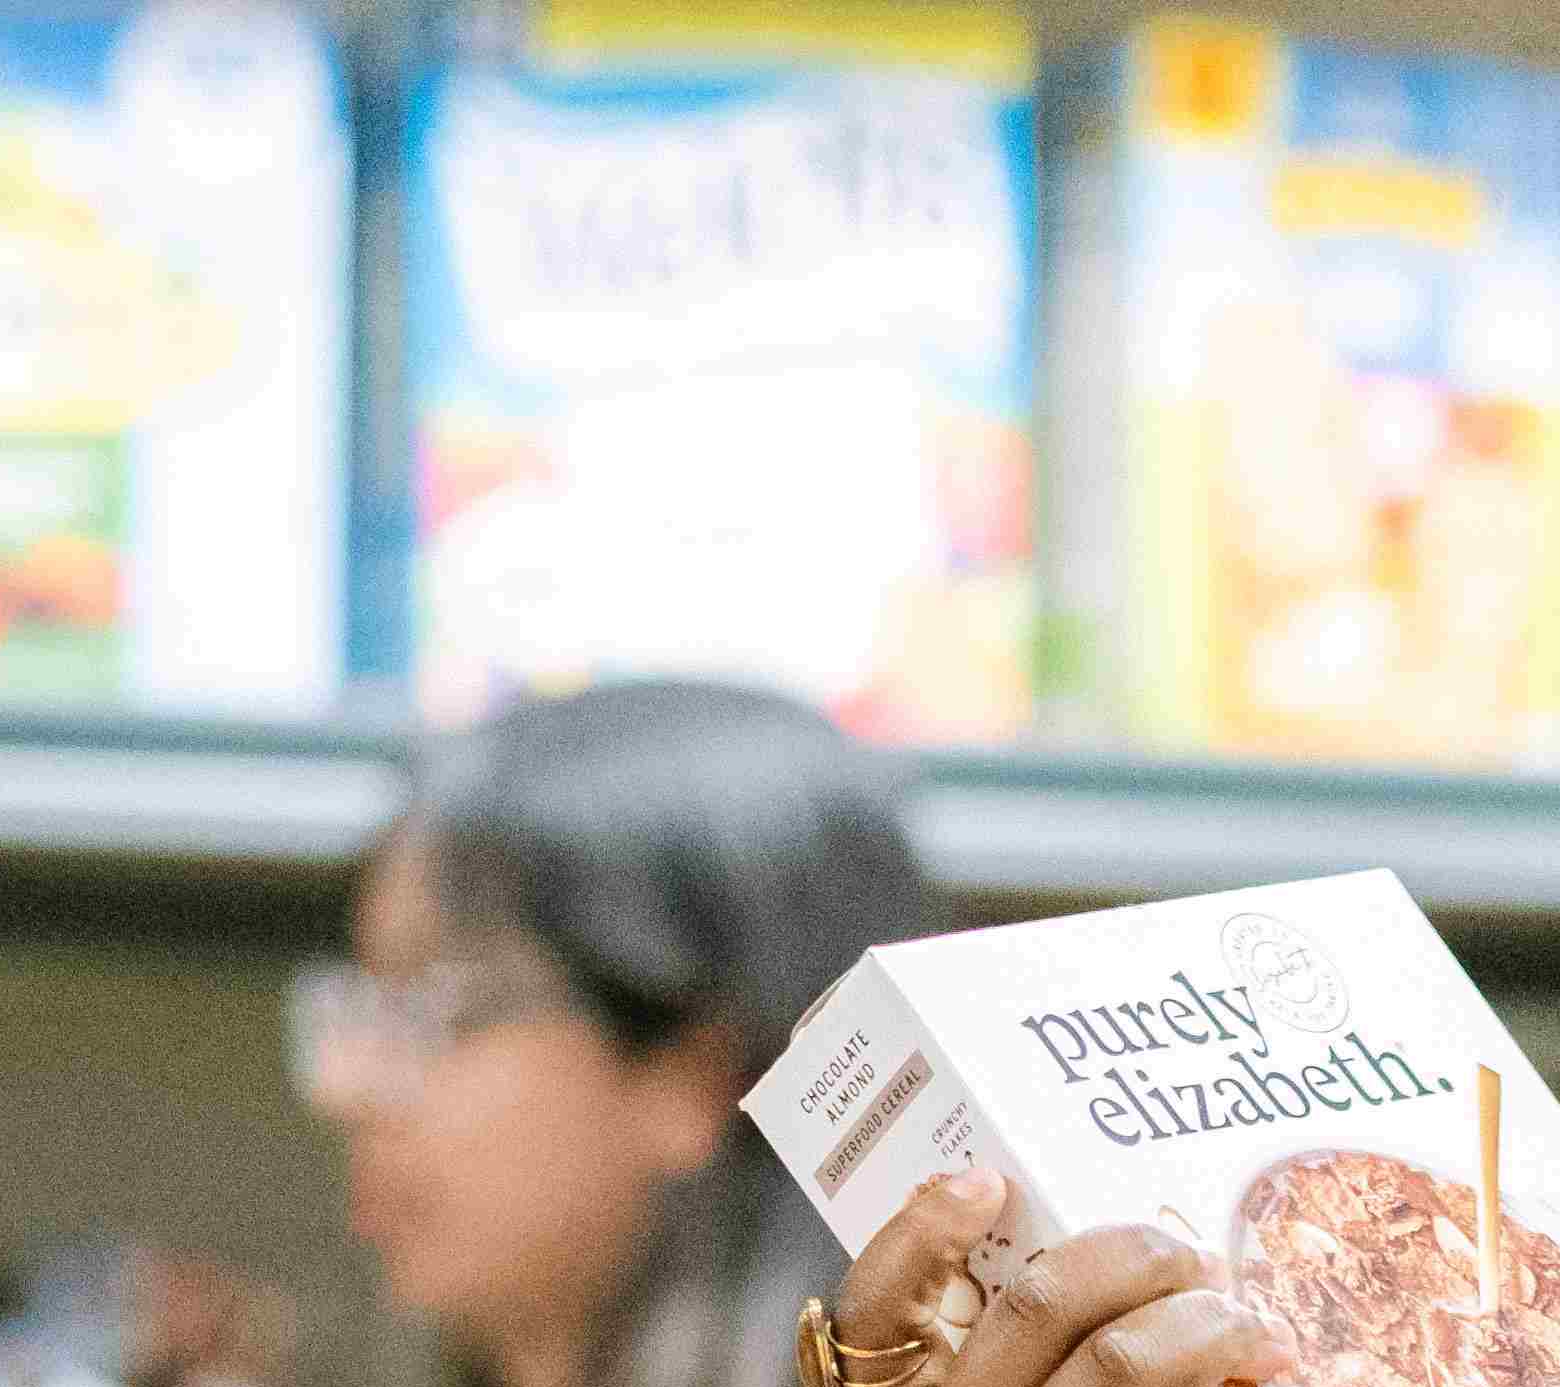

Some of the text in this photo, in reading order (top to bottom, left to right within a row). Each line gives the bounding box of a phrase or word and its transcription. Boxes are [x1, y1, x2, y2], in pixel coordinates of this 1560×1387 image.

[800, 1029, 869, 1114] CHOCOLATE
[1022, 971, 1268, 1084] purely
[825, 1062, 875, 1125] ALMOND
[826, 1068, 921, 1182] SUPERFOOD CEREAL
[1089, 1031, 1453, 1147] elizabeth.
[941, 1121, 974, 1159] FLAKES
